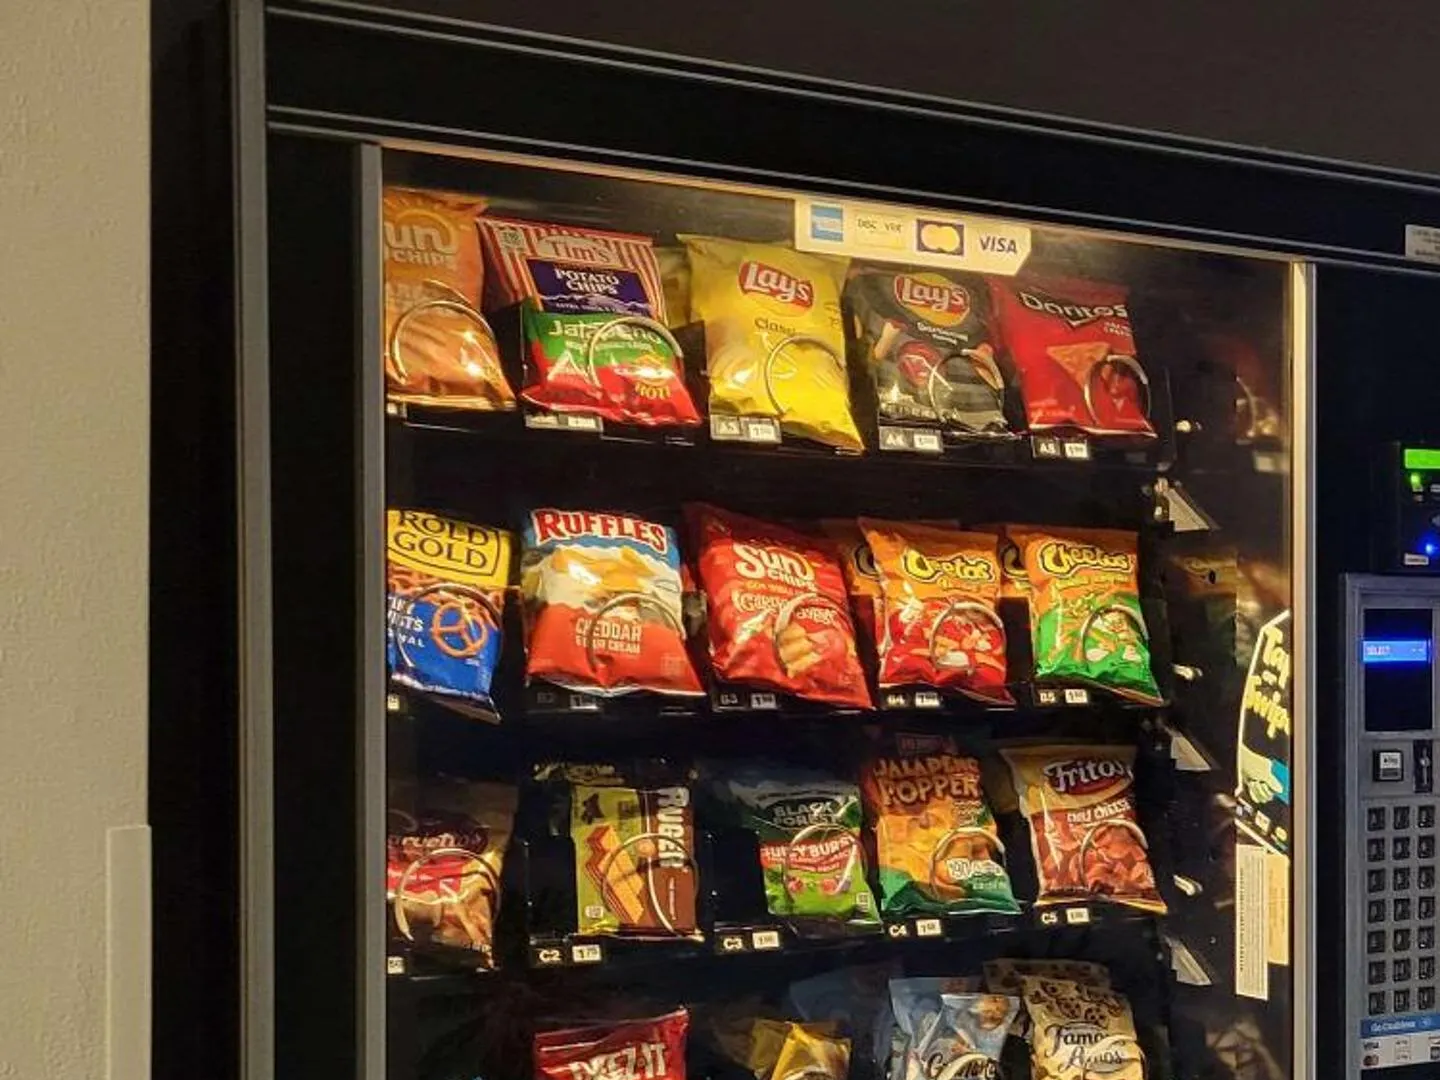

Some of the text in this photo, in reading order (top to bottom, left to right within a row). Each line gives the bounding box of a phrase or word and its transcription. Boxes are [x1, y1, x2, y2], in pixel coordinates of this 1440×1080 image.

[979, 235, 1018, 255] VISA
[555, 268, 620, 286] POTATO
[566, 280, 619, 296] CHIPS
[1019, 291, 1129, 327] Doritos
[399, 511, 490, 547] ROLD
[533, 510, 667, 553] RUFFLES
[394, 530, 488, 570] GOLD
[732, 542, 817, 580] Sun
[1039, 541, 1132, 576] Cheetos
[575, 617, 642, 641] CHEDDAR
[1043, 759, 1134, 792] Fritos
[773, 801, 834, 818] BLACK
[889, 924, 908, 937] C4
[723, 937, 744, 950] C3
[539, 949, 562, 963] C2
